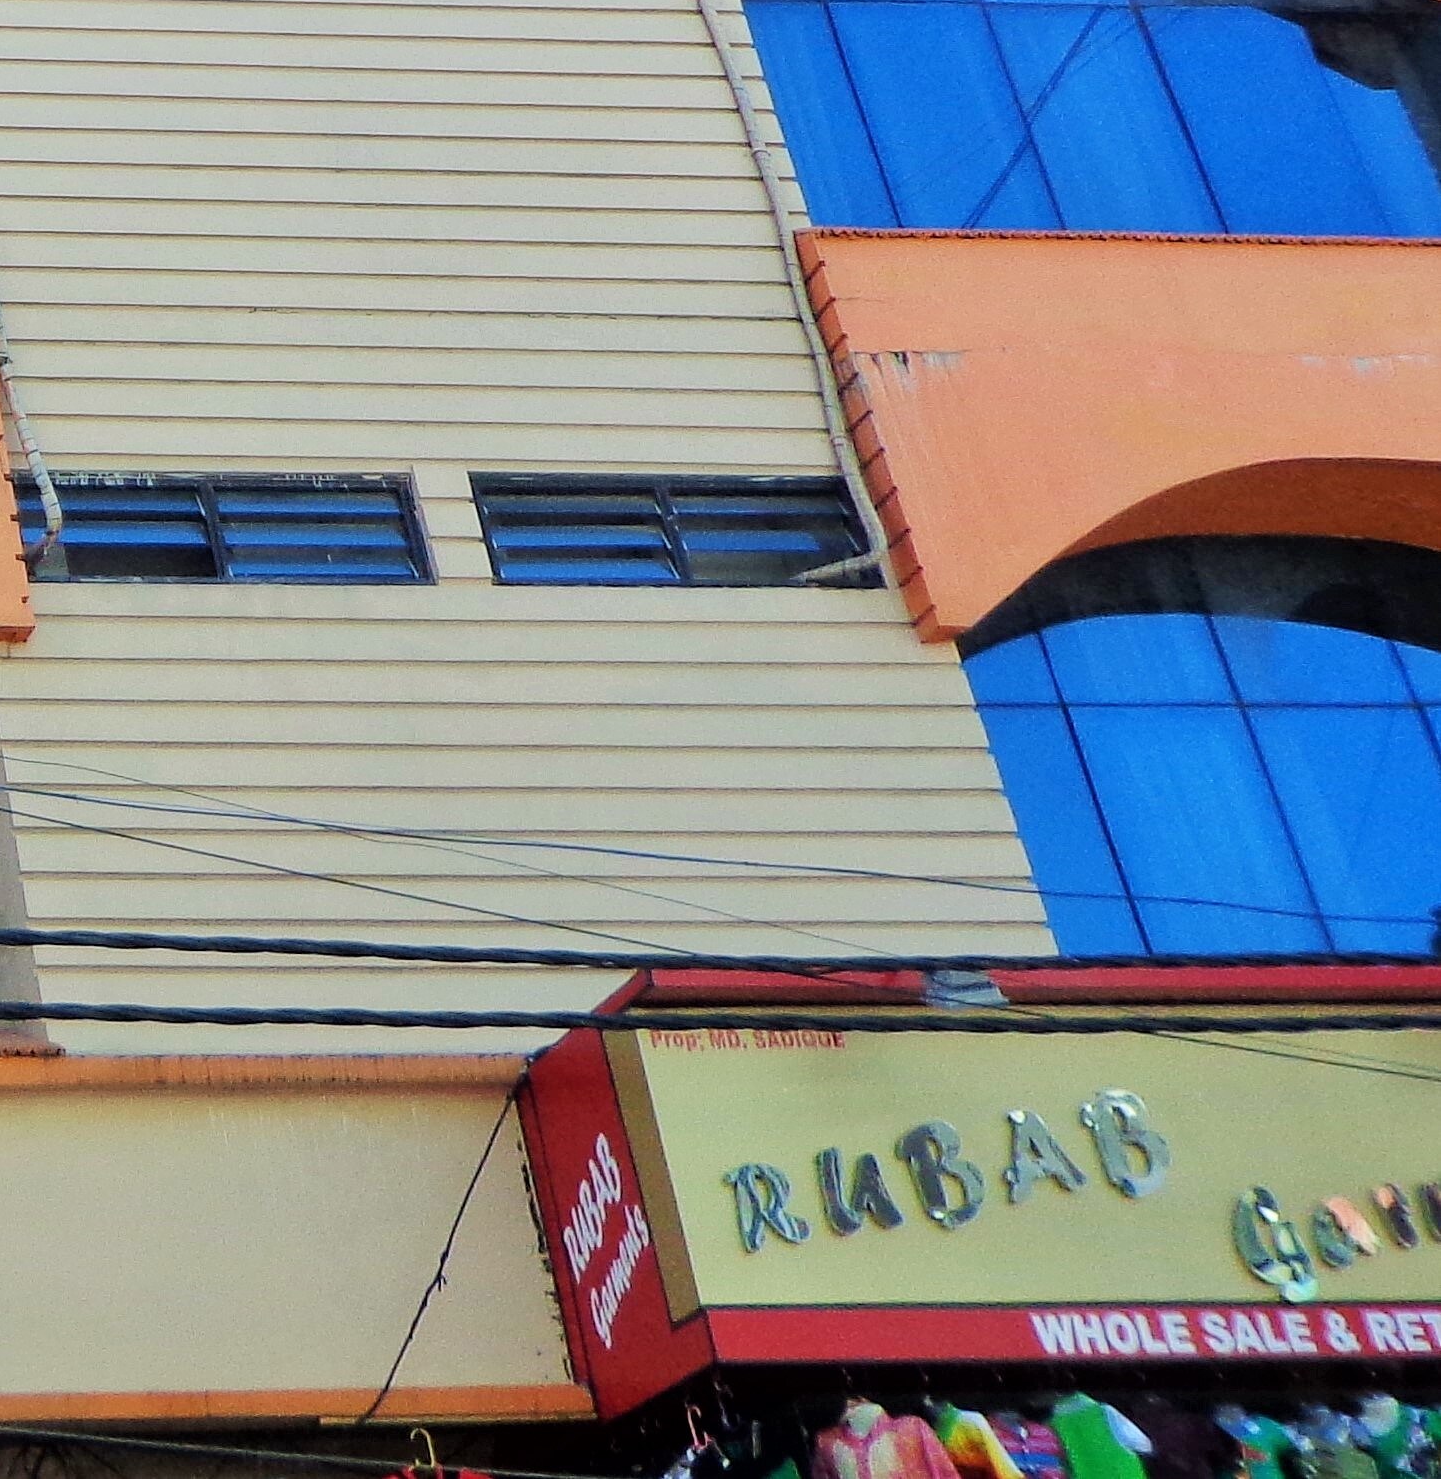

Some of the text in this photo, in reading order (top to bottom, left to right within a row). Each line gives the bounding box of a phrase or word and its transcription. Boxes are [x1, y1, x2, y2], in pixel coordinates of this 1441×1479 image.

[1029, 1309, 1198, 1357] WHOLE
[1200, 1308, 1319, 1355] SALE
[1323, 1308, 1362, 1354] &
